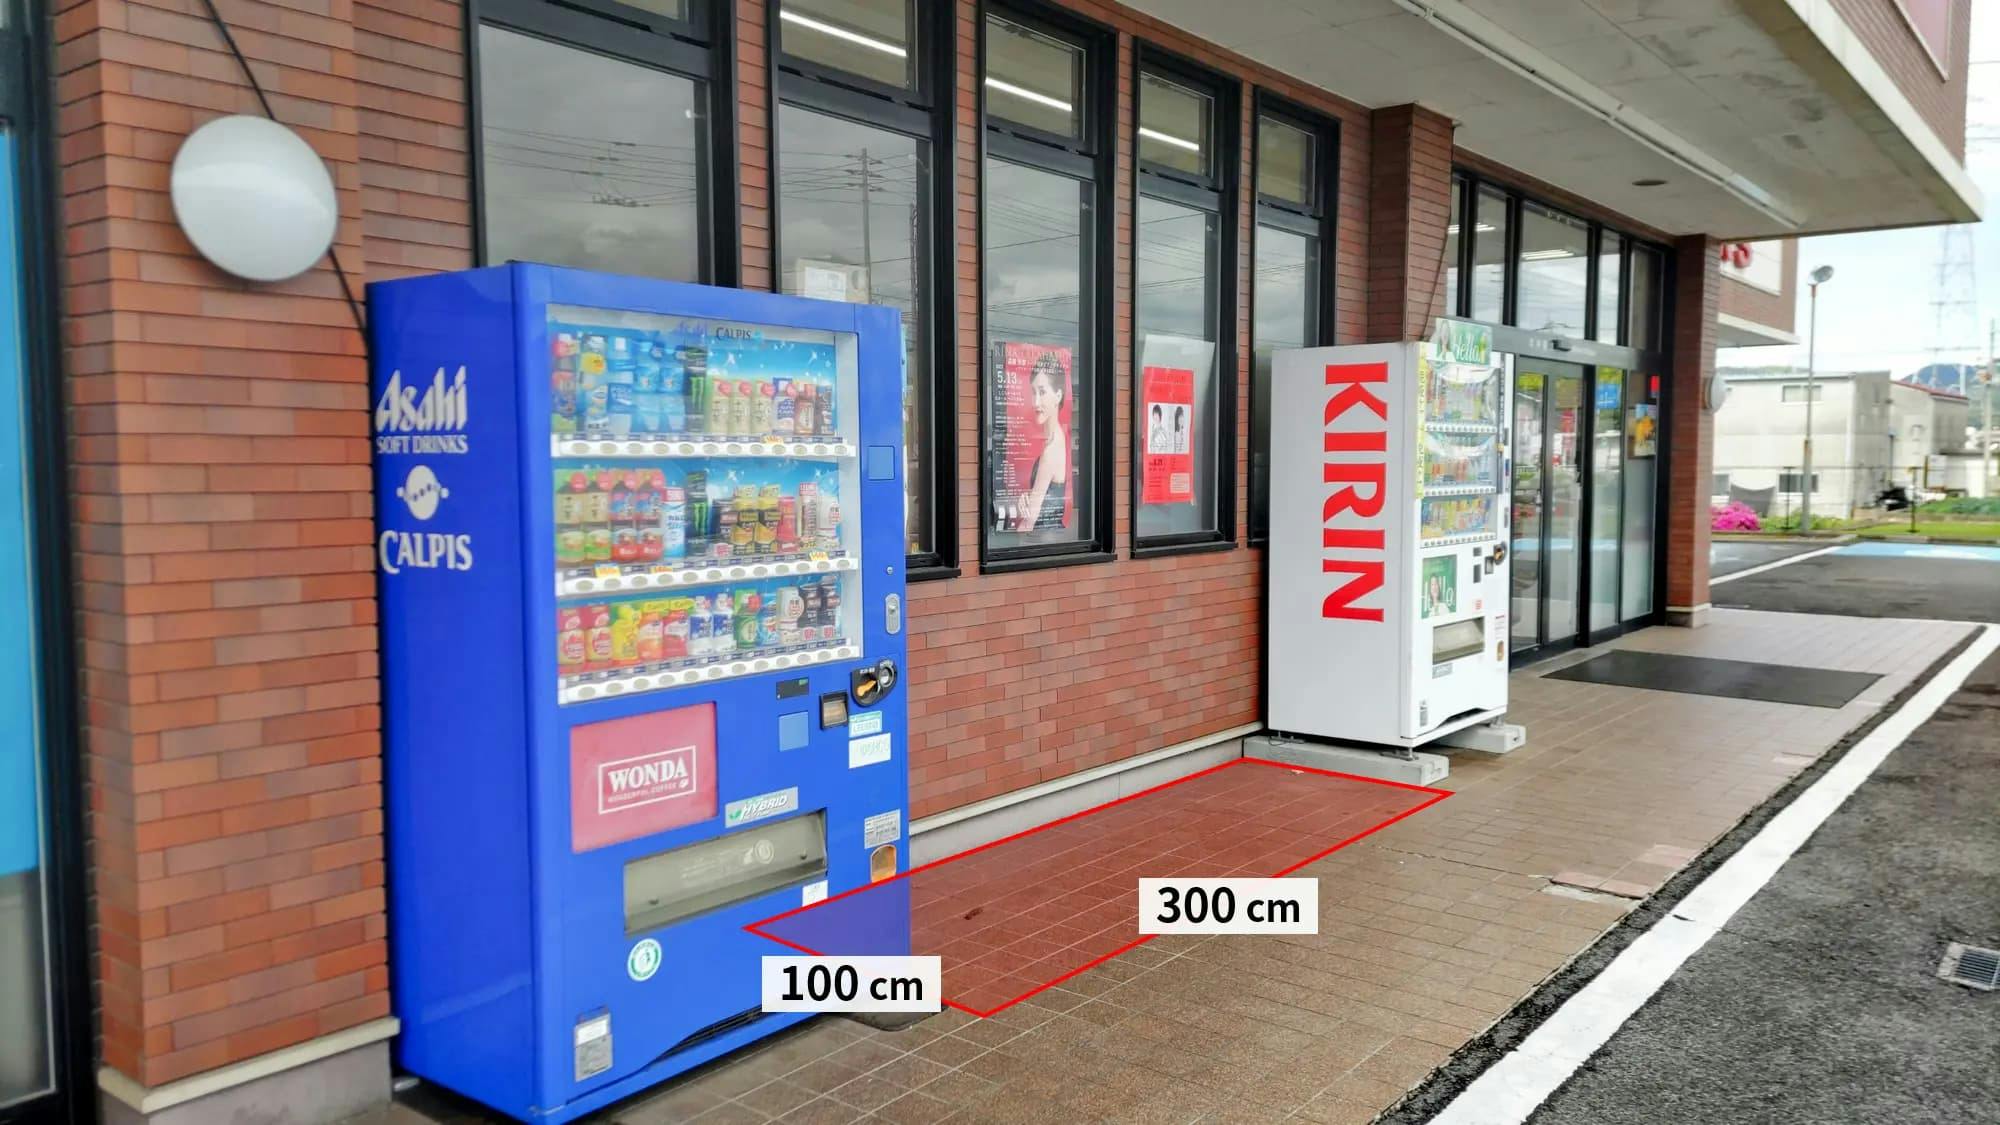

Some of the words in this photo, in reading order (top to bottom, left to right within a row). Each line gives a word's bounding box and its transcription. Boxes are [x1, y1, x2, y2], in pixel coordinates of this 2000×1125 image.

[715, 327, 752, 341] CALPIS
[374, 365, 468, 433] Asahi
[376, 435, 411, 455] SOFT
[412, 434, 469, 455] DRINKS
[1322, 361, 1388, 623] KIRIN
[379, 529, 473, 575] CALPIS
[608, 756, 689, 793] WONDA
